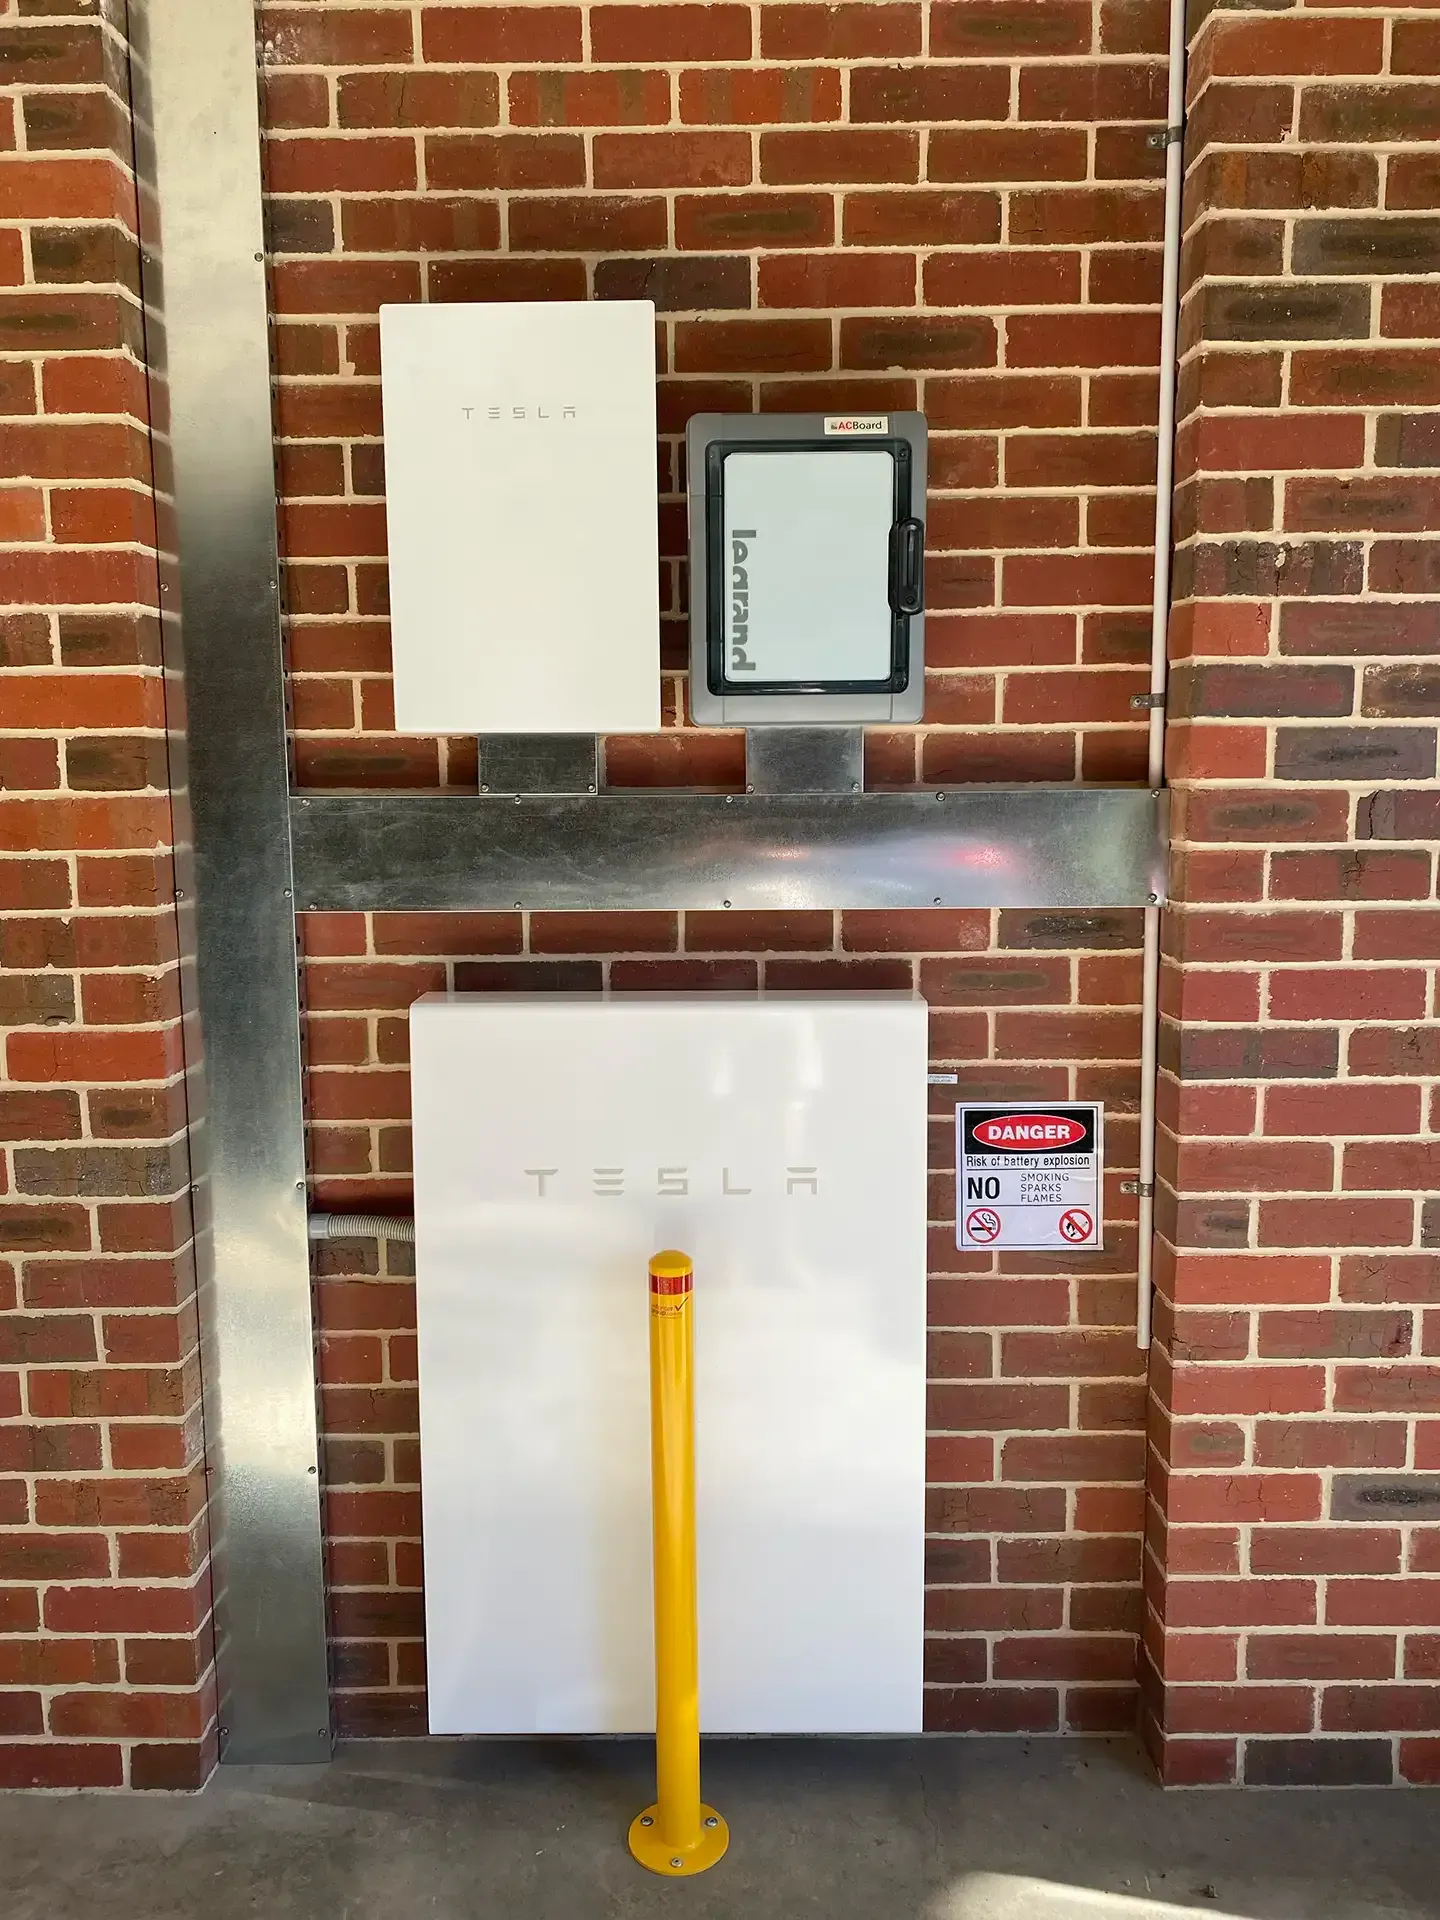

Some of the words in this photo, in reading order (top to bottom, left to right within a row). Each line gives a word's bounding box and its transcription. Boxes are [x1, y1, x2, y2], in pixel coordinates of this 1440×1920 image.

[461, 406, 576, 420] TESLA
[838, 420, 882, 430] ACBoard
[988, 1125, 1071, 1140] DANGER
[966, 1155, 988, 1167] Risk
[991, 1155, 1001, 1166] of
[1004, 1155, 1040, 1168] battery
[1043, 1154, 1090, 1168] explosion
[524, 1167, 818, 1197] TESLA
[1020, 1172, 1070, 1182] SMOKING
[967, 1176, 1001, 1200] NO
[1020, 1183, 1062, 1193] SPARKS
[1020, 1193, 1062, 1203] FLAMES
